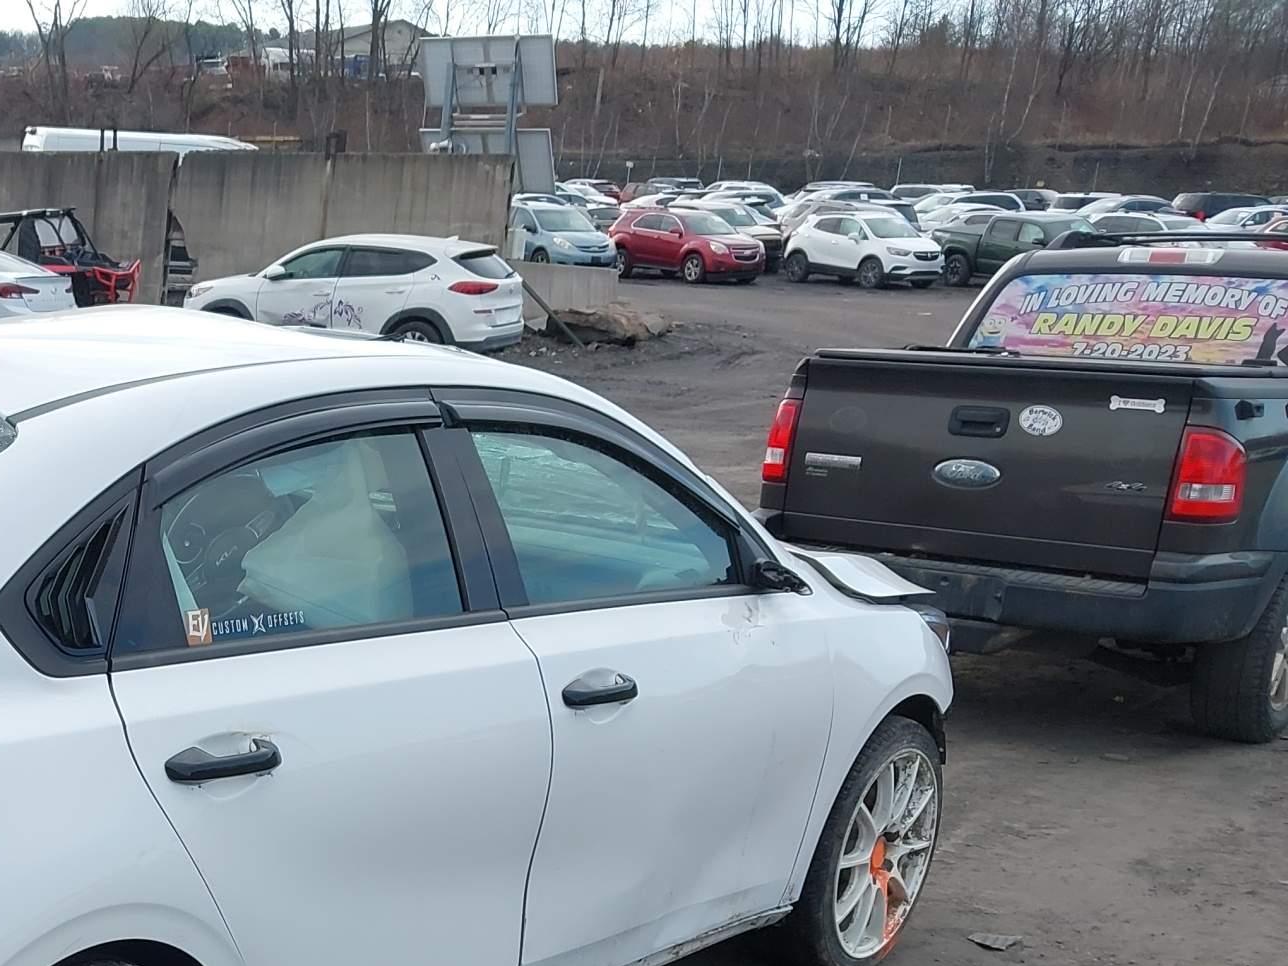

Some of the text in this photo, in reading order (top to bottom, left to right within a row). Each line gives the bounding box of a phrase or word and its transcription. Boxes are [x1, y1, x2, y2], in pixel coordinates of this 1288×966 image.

[1019, 281, 1288, 319] IN LOVING MEMORY OF
[1031, 312, 1259, 342] RANDY DAVIS
[1071, 342, 1193, 362] 7-20-2023
[212, 610, 305, 636] CUSTOM OFFSETS
